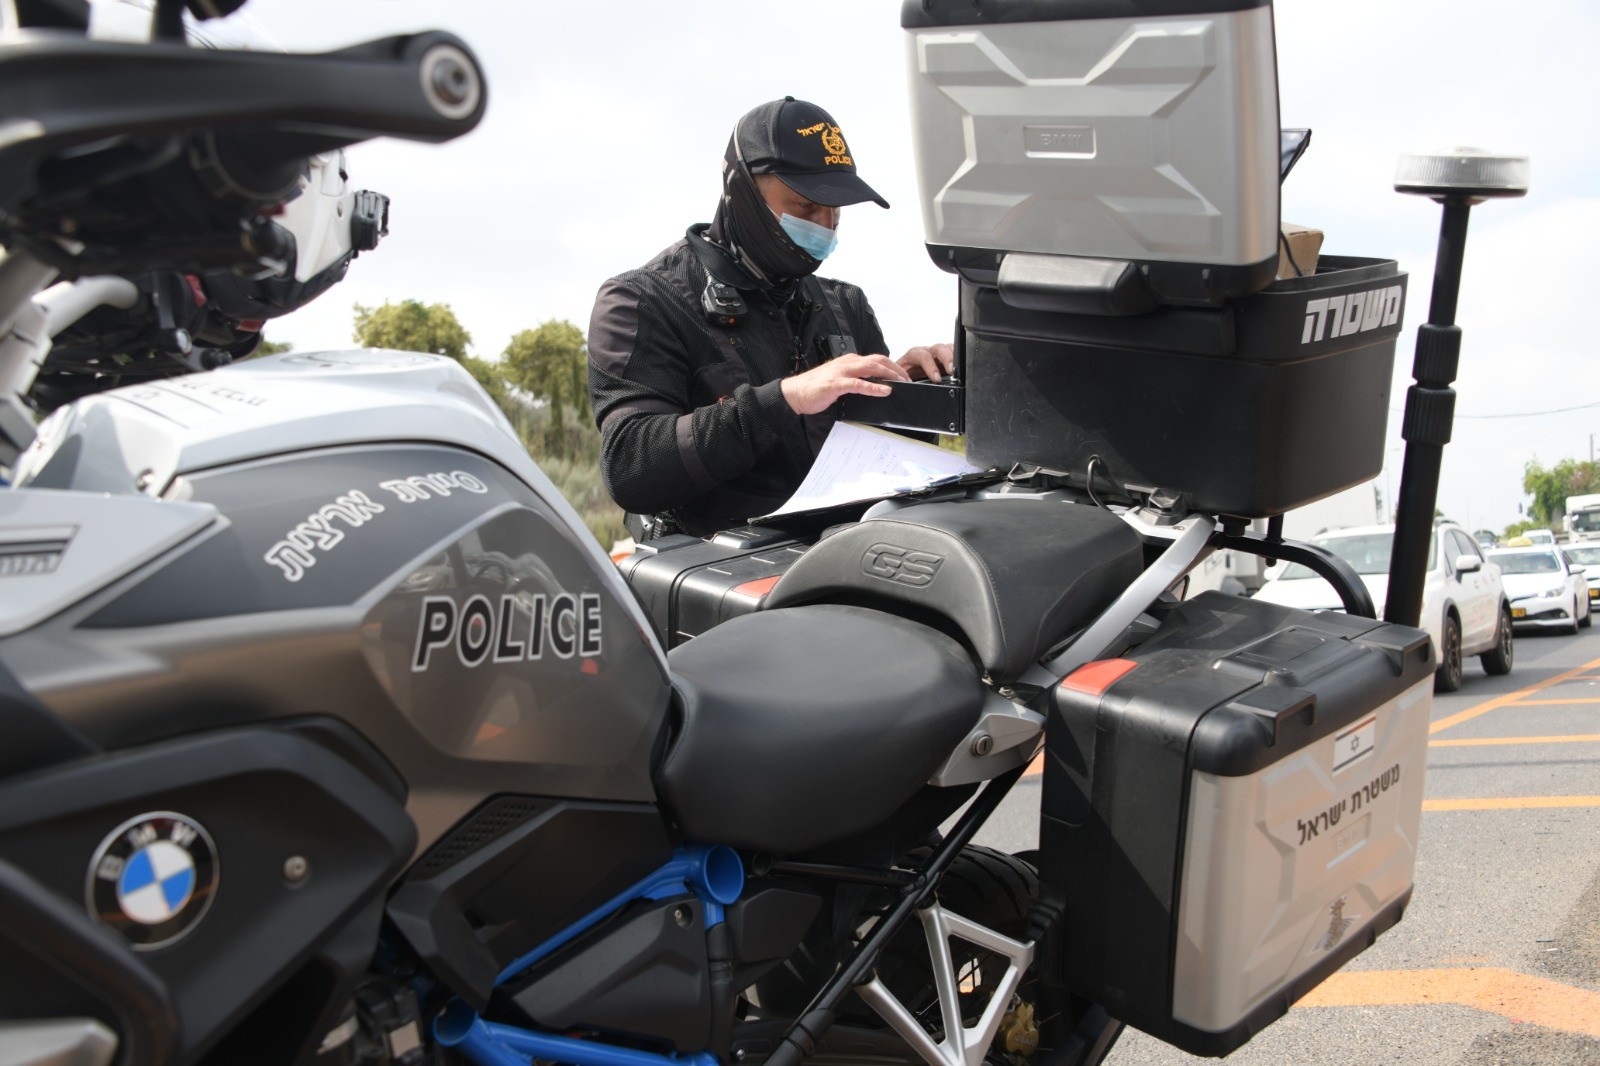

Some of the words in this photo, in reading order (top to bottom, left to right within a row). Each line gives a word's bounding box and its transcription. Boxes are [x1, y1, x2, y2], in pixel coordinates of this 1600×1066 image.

[1301, 285, 1402, 344] משטרה
[378, 470, 488, 503] סיירת
[263, 489, 385, 582] ארצית
[861, 542, 945, 588] GS
[411, 593, 602, 672] POLICE
[1350, 763, 1400, 814] משטרת
[1296, 799, 1346, 846] ישראל
[97, 820, 198, 883] BMW
